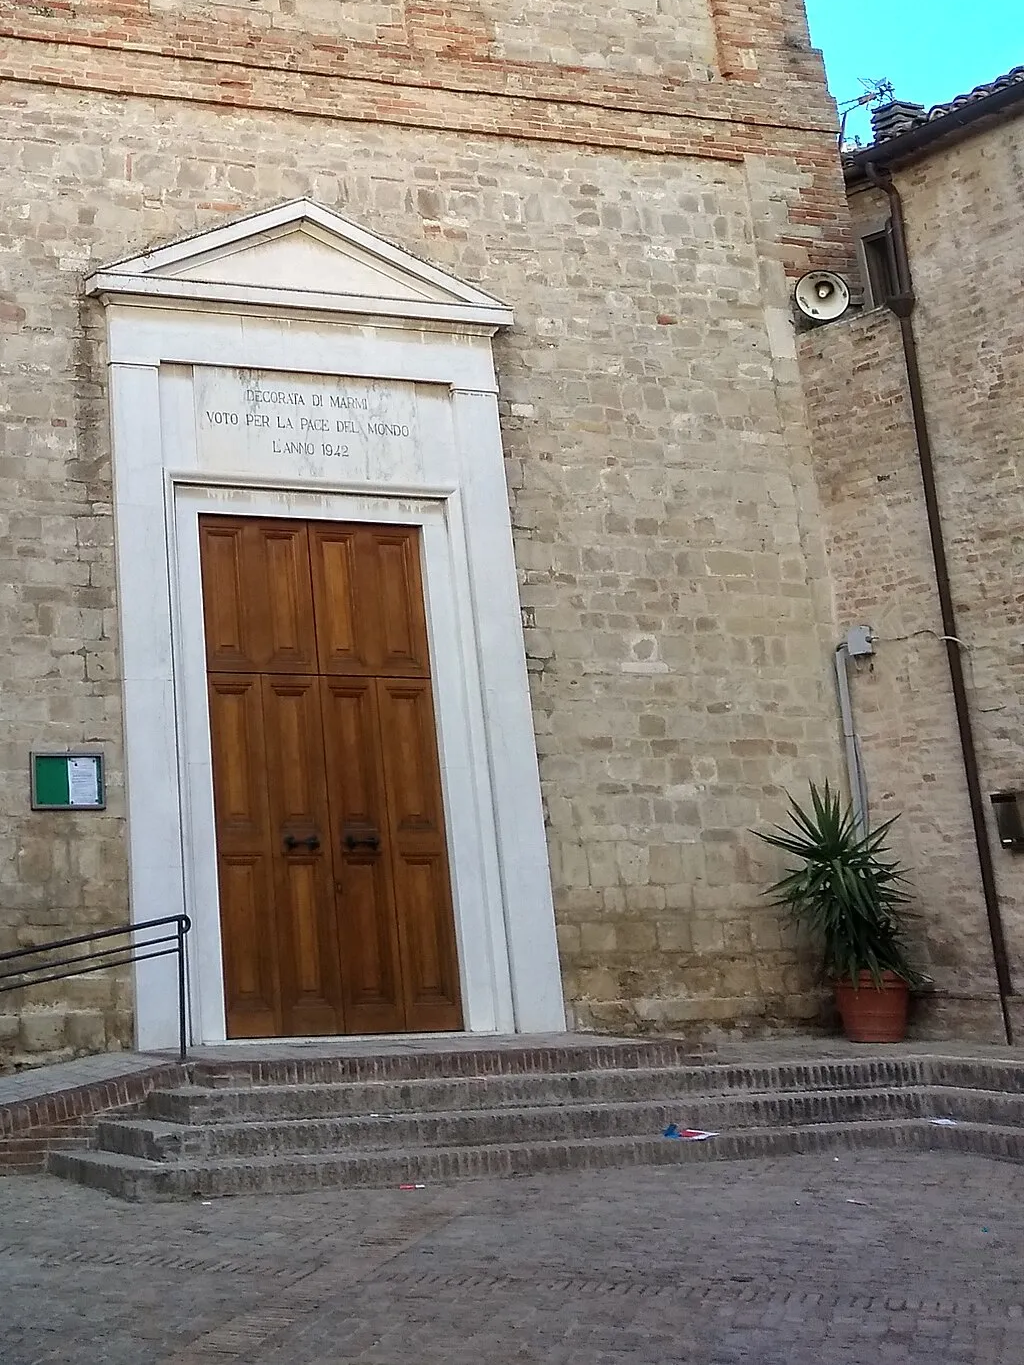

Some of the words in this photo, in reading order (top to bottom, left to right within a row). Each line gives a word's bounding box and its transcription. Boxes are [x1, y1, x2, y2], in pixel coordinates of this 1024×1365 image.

[246, 389, 306, 406] DECORATA
[312, 394, 324, 407] DI
[329, 395, 369, 410] MARMI
[206, 411, 239, 425] VOTO
[245, 413, 271, 428] PER
[276, 416, 294, 430] LA
[300, 417, 331, 432] PACE
[336, 419, 360, 434] DEL
[367, 422, 410, 437] MONDO
[321, 443, 350, 458] 1942
